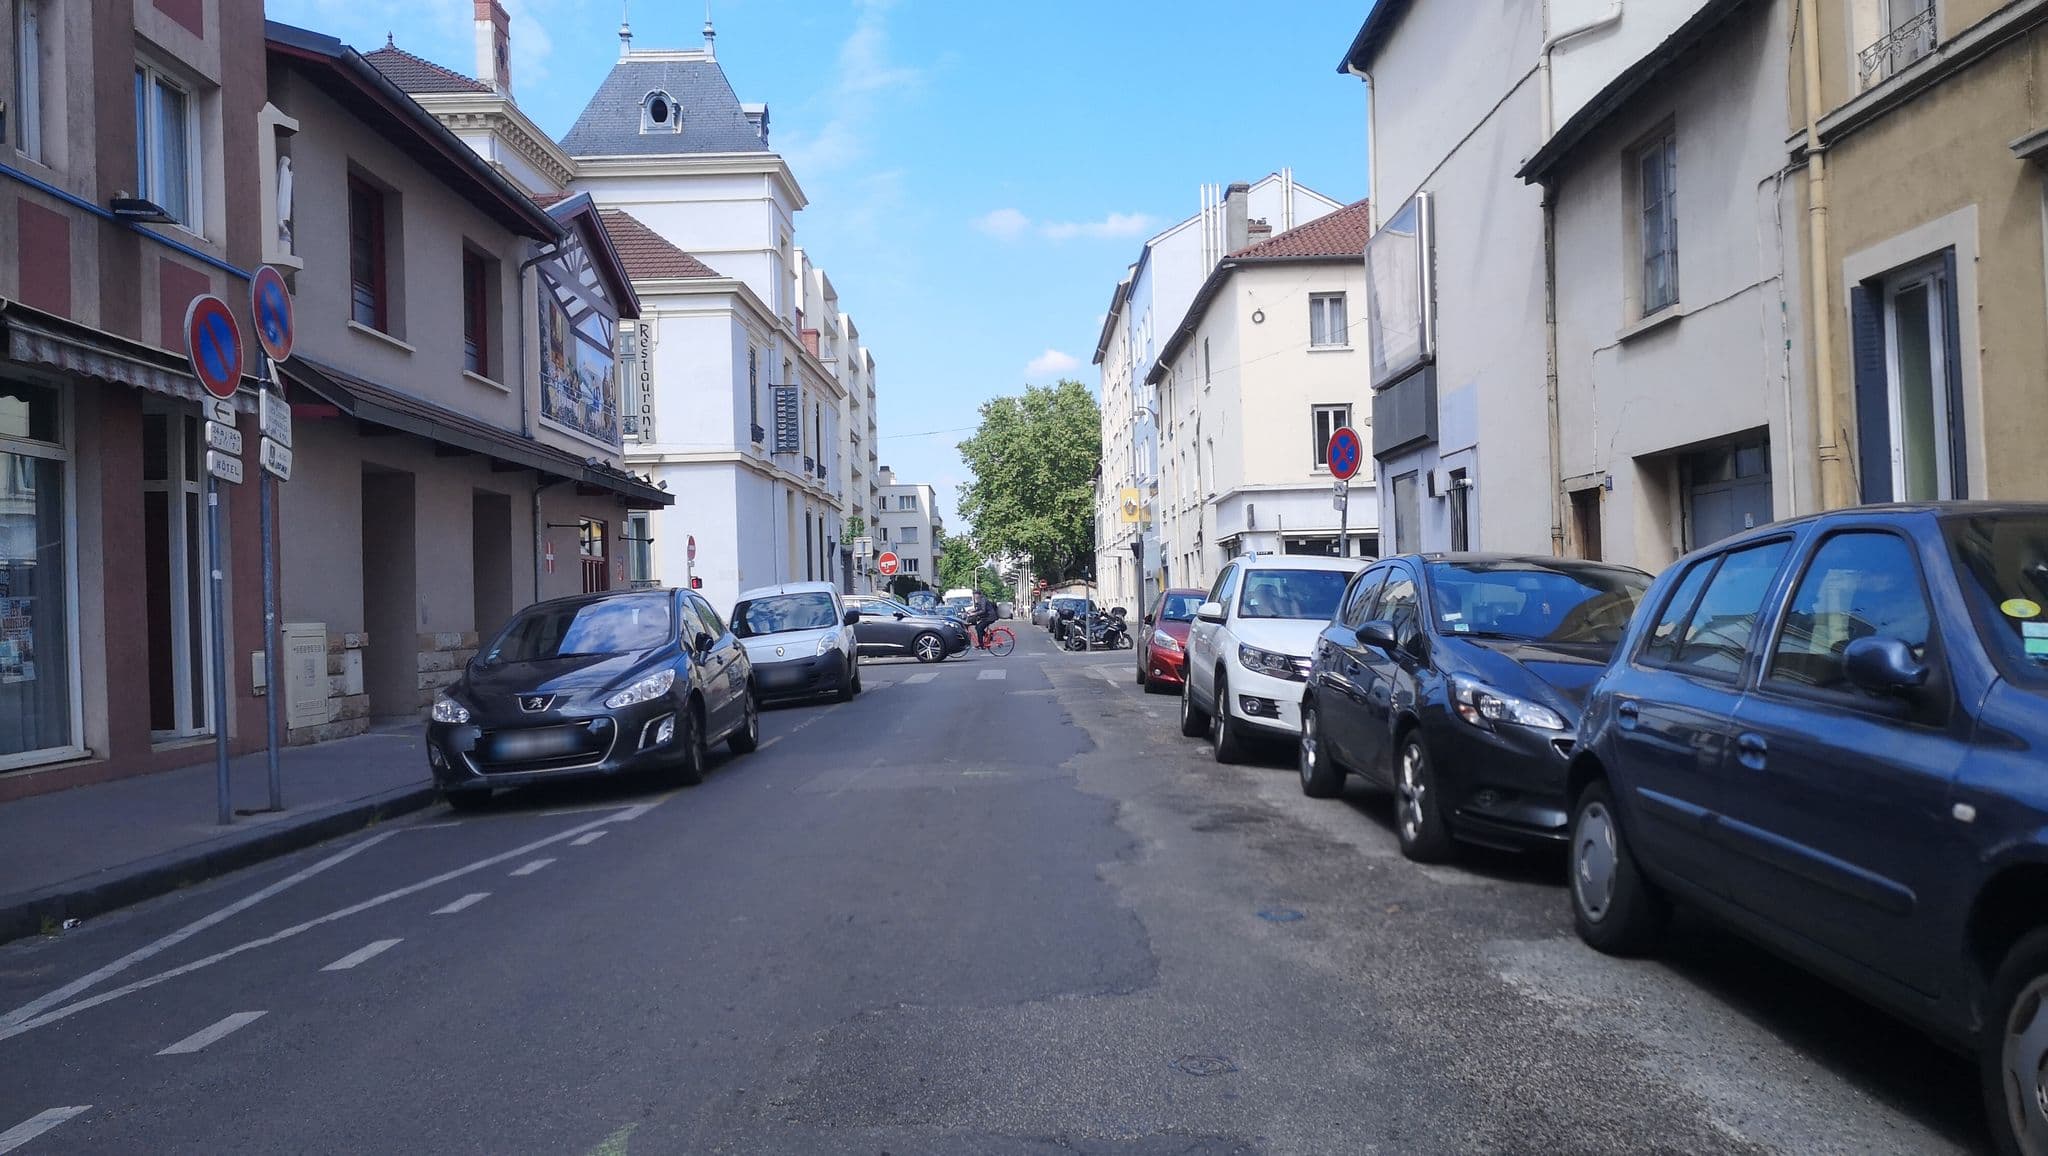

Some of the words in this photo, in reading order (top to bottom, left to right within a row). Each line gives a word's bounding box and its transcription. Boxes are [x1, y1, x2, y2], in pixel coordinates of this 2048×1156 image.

[639, 323, 652, 440] Restaurant
[777, 390, 787, 448] MARGUERITE
[787, 390, 798, 447] RESTAURANT
